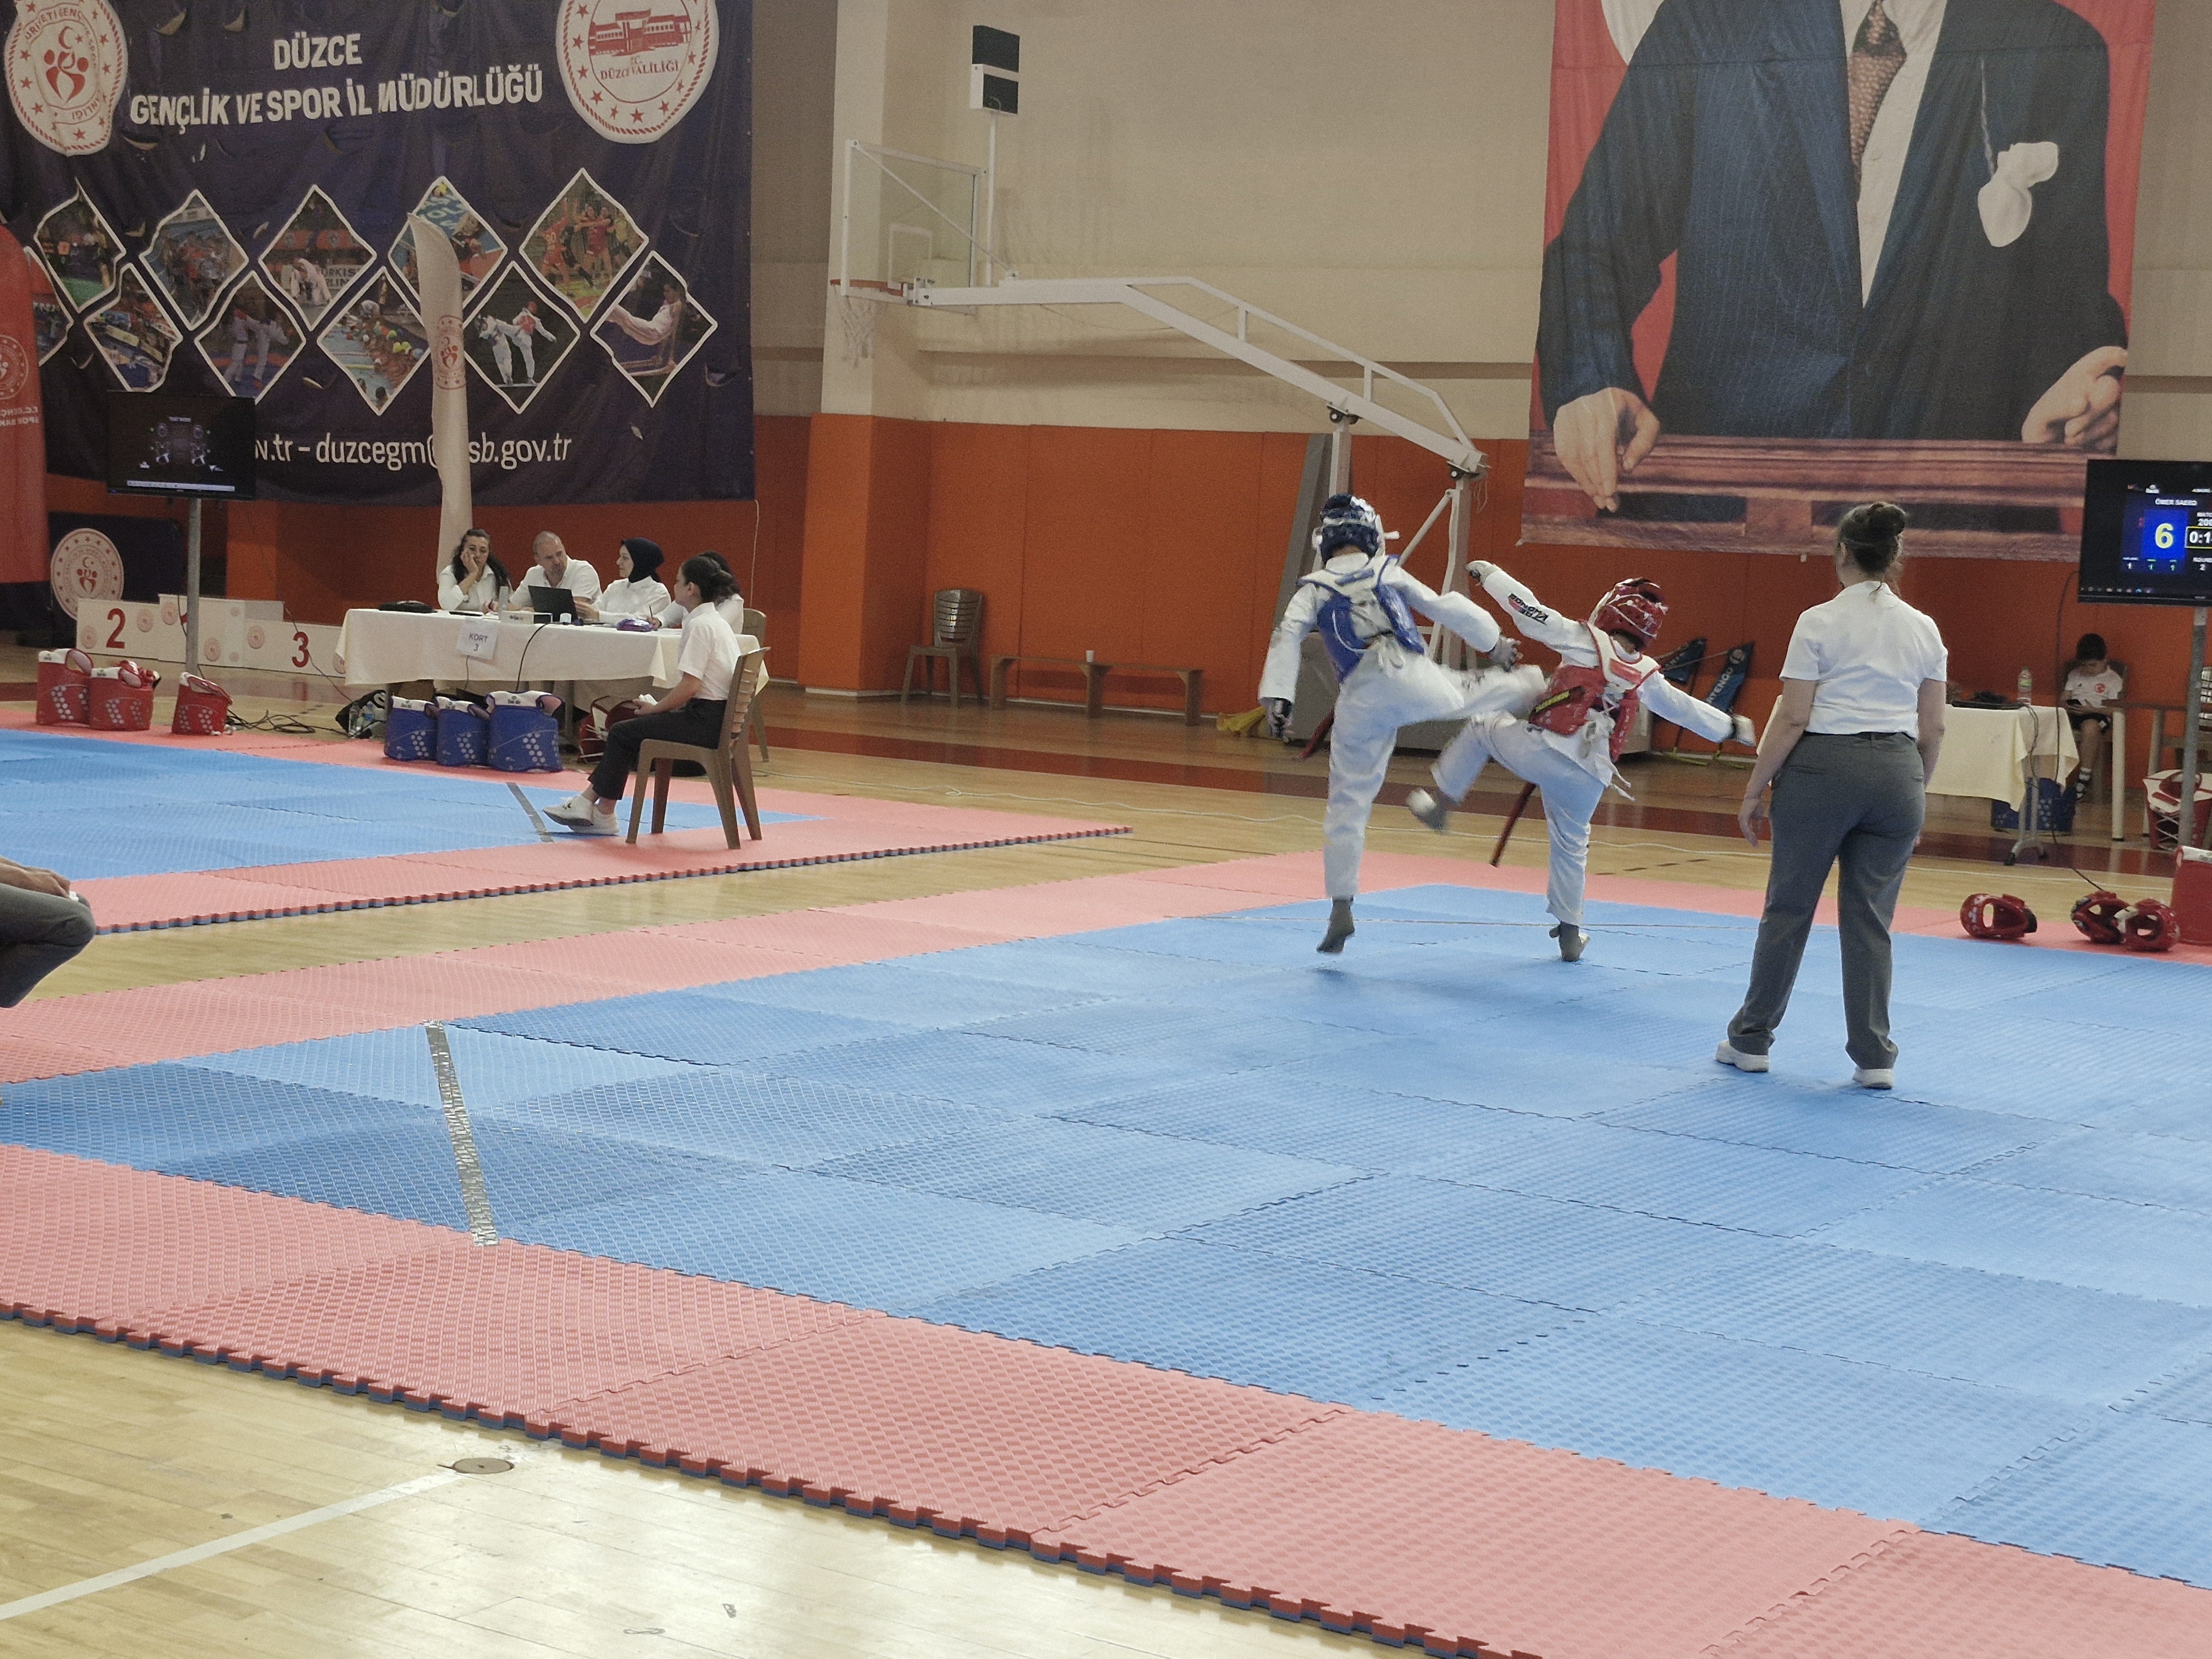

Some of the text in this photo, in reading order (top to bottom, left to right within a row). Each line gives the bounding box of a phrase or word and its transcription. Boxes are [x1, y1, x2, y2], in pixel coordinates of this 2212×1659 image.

[274, 31, 363, 70] DÜZCE
[601, 67, 629, 80] DÜZC
[130, 64, 542, 134] GENÇLİK VE SPOR İL MÜDÜRLÜĞÜ
[316, 432, 572, 470] duzcegmsb.gov.tr
[2155, 523, 2173, 549] 6
[2189, 531, 2212, 543] 0:1
[106, 608, 126, 649] 2
[469, 633, 488, 643] KORT
[291, 631, 309, 668] 3
[473, 643, 479, 652] 3
[1705, 667, 1734, 703] RTENGO
